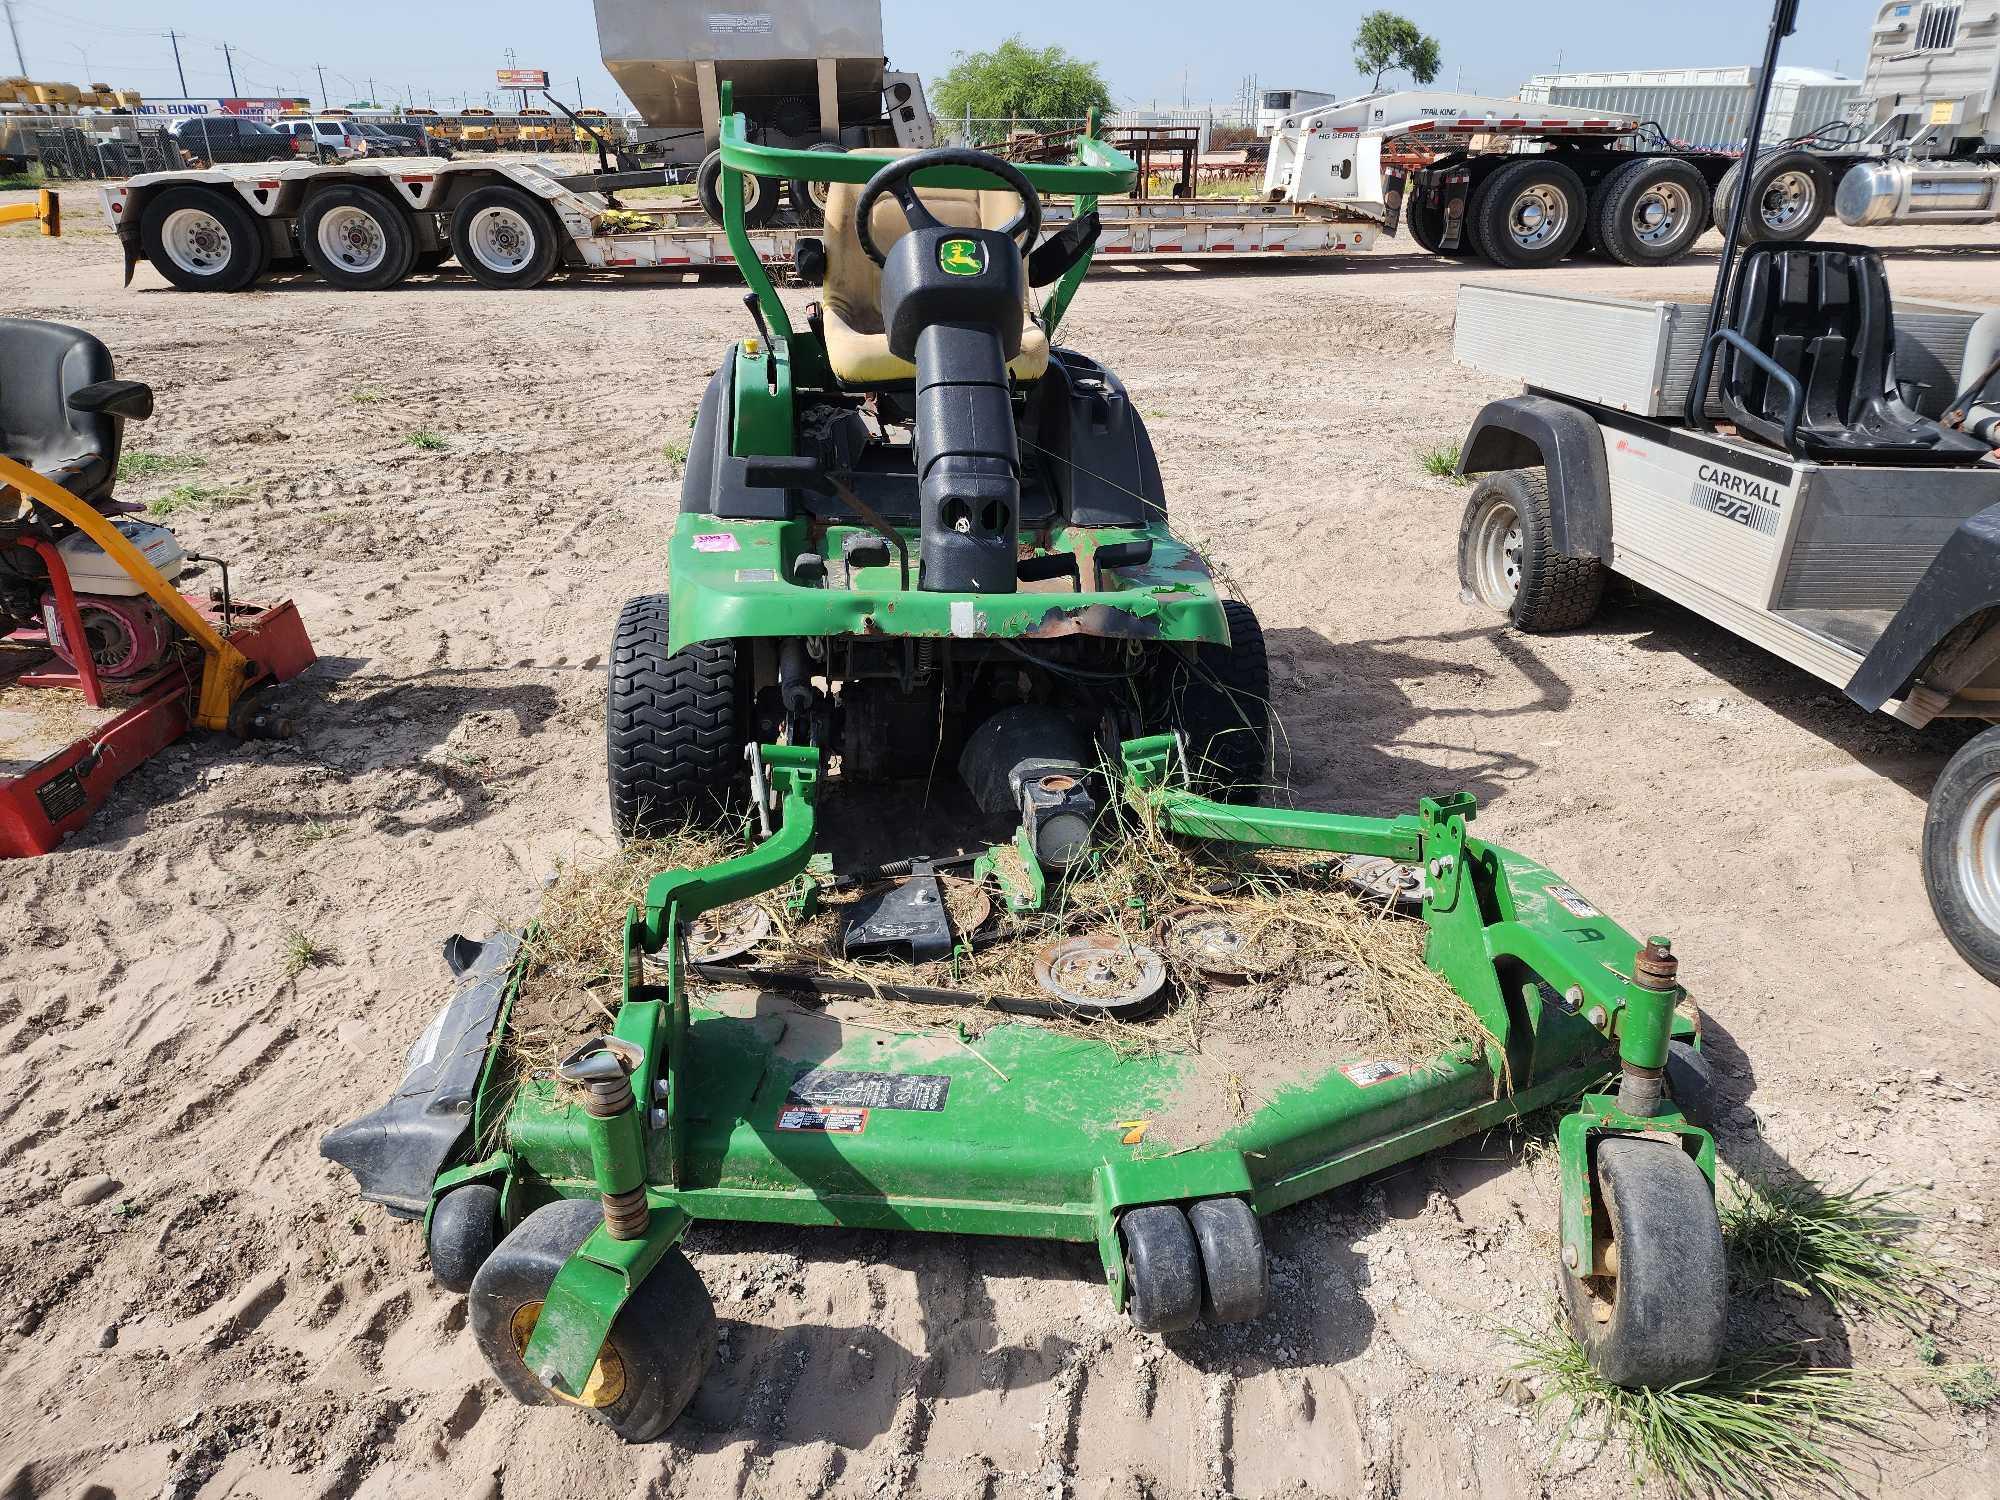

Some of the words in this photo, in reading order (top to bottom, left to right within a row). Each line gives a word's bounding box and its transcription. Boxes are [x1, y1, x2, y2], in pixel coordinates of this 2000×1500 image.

[167, 104, 208, 115] BOND
[1421, 108, 1440, 116] TRAIL
[1440, 108, 1457, 116] KING
[1332, 132, 1361, 140] SERIES
[1698, 464, 1781, 508] CARRYALL
[1715, 493, 1752, 524] 272
